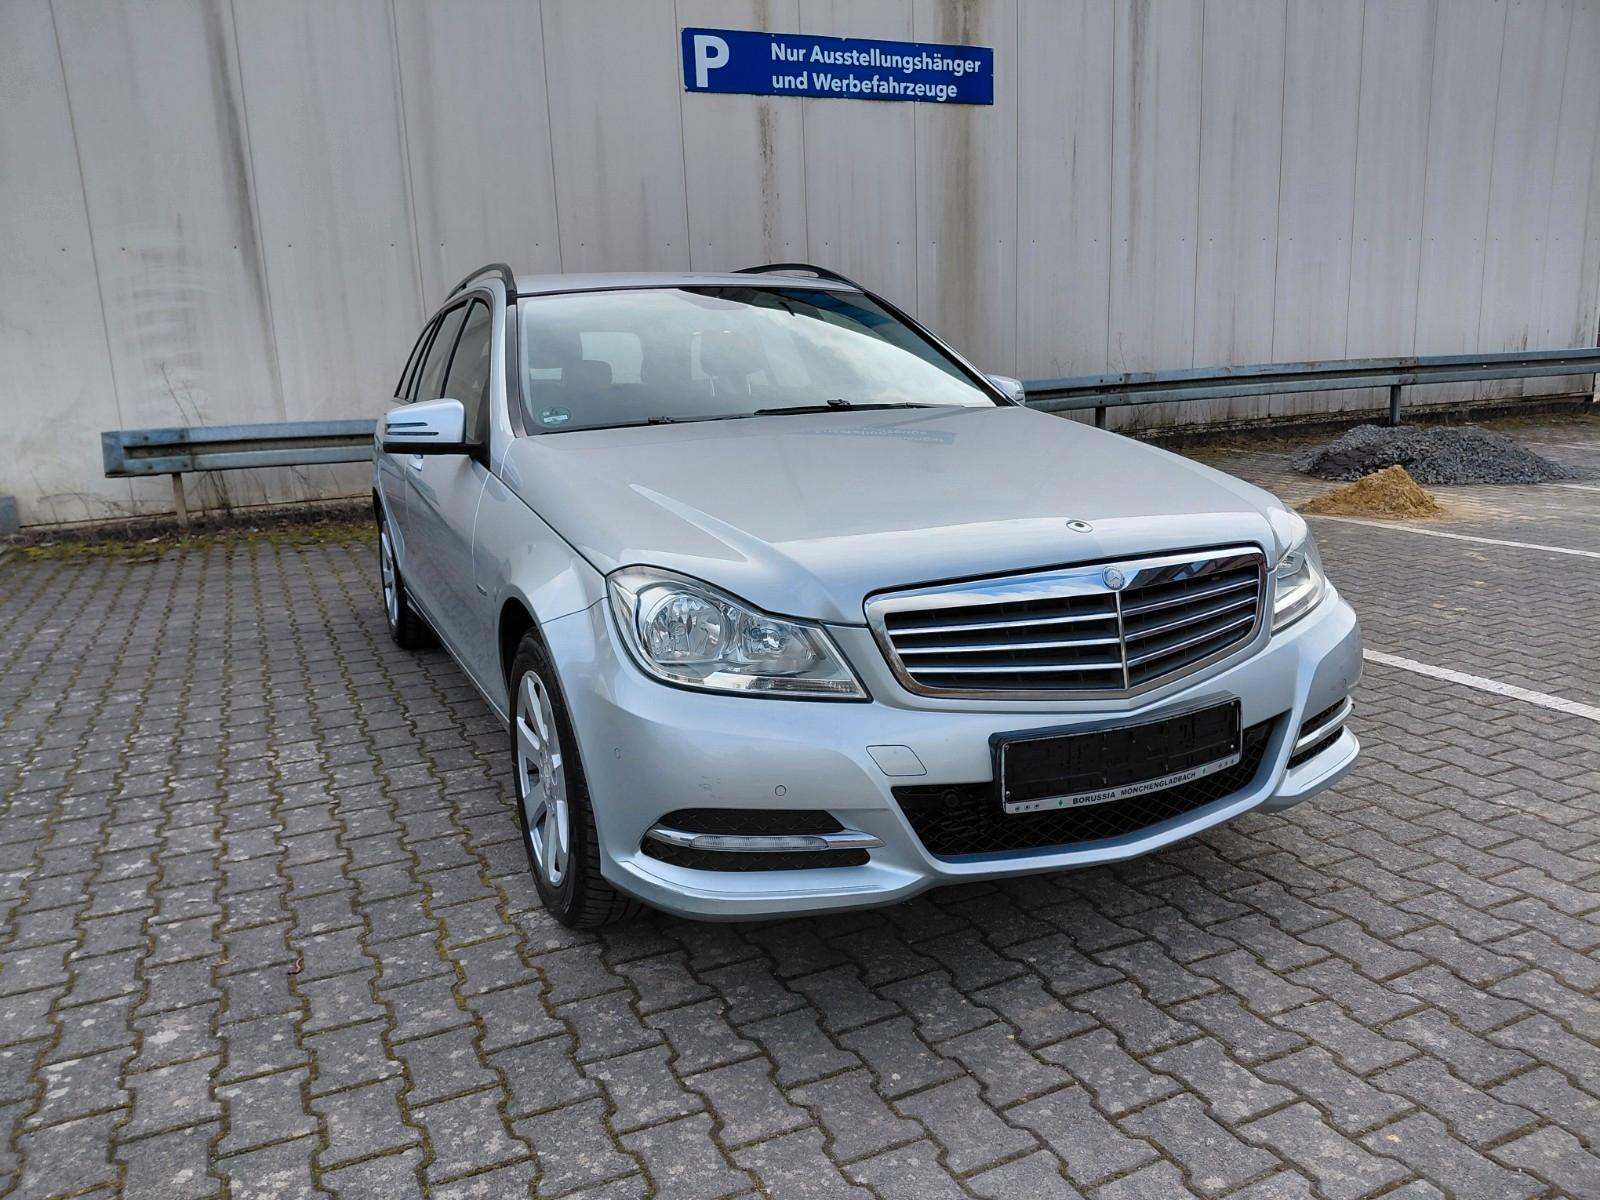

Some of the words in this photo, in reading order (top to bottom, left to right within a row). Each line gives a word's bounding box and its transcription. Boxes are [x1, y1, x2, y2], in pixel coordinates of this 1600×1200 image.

[693, 34, 730, 88] P
[771, 43, 806, 62] Nur
[810, 45, 981, 76] Ausstellungshänger
[772, 71, 808, 90] und
[813, 73, 958, 101] Werbefahrzeuge
[1072, 791, 1116, 805] BORUSSIA
